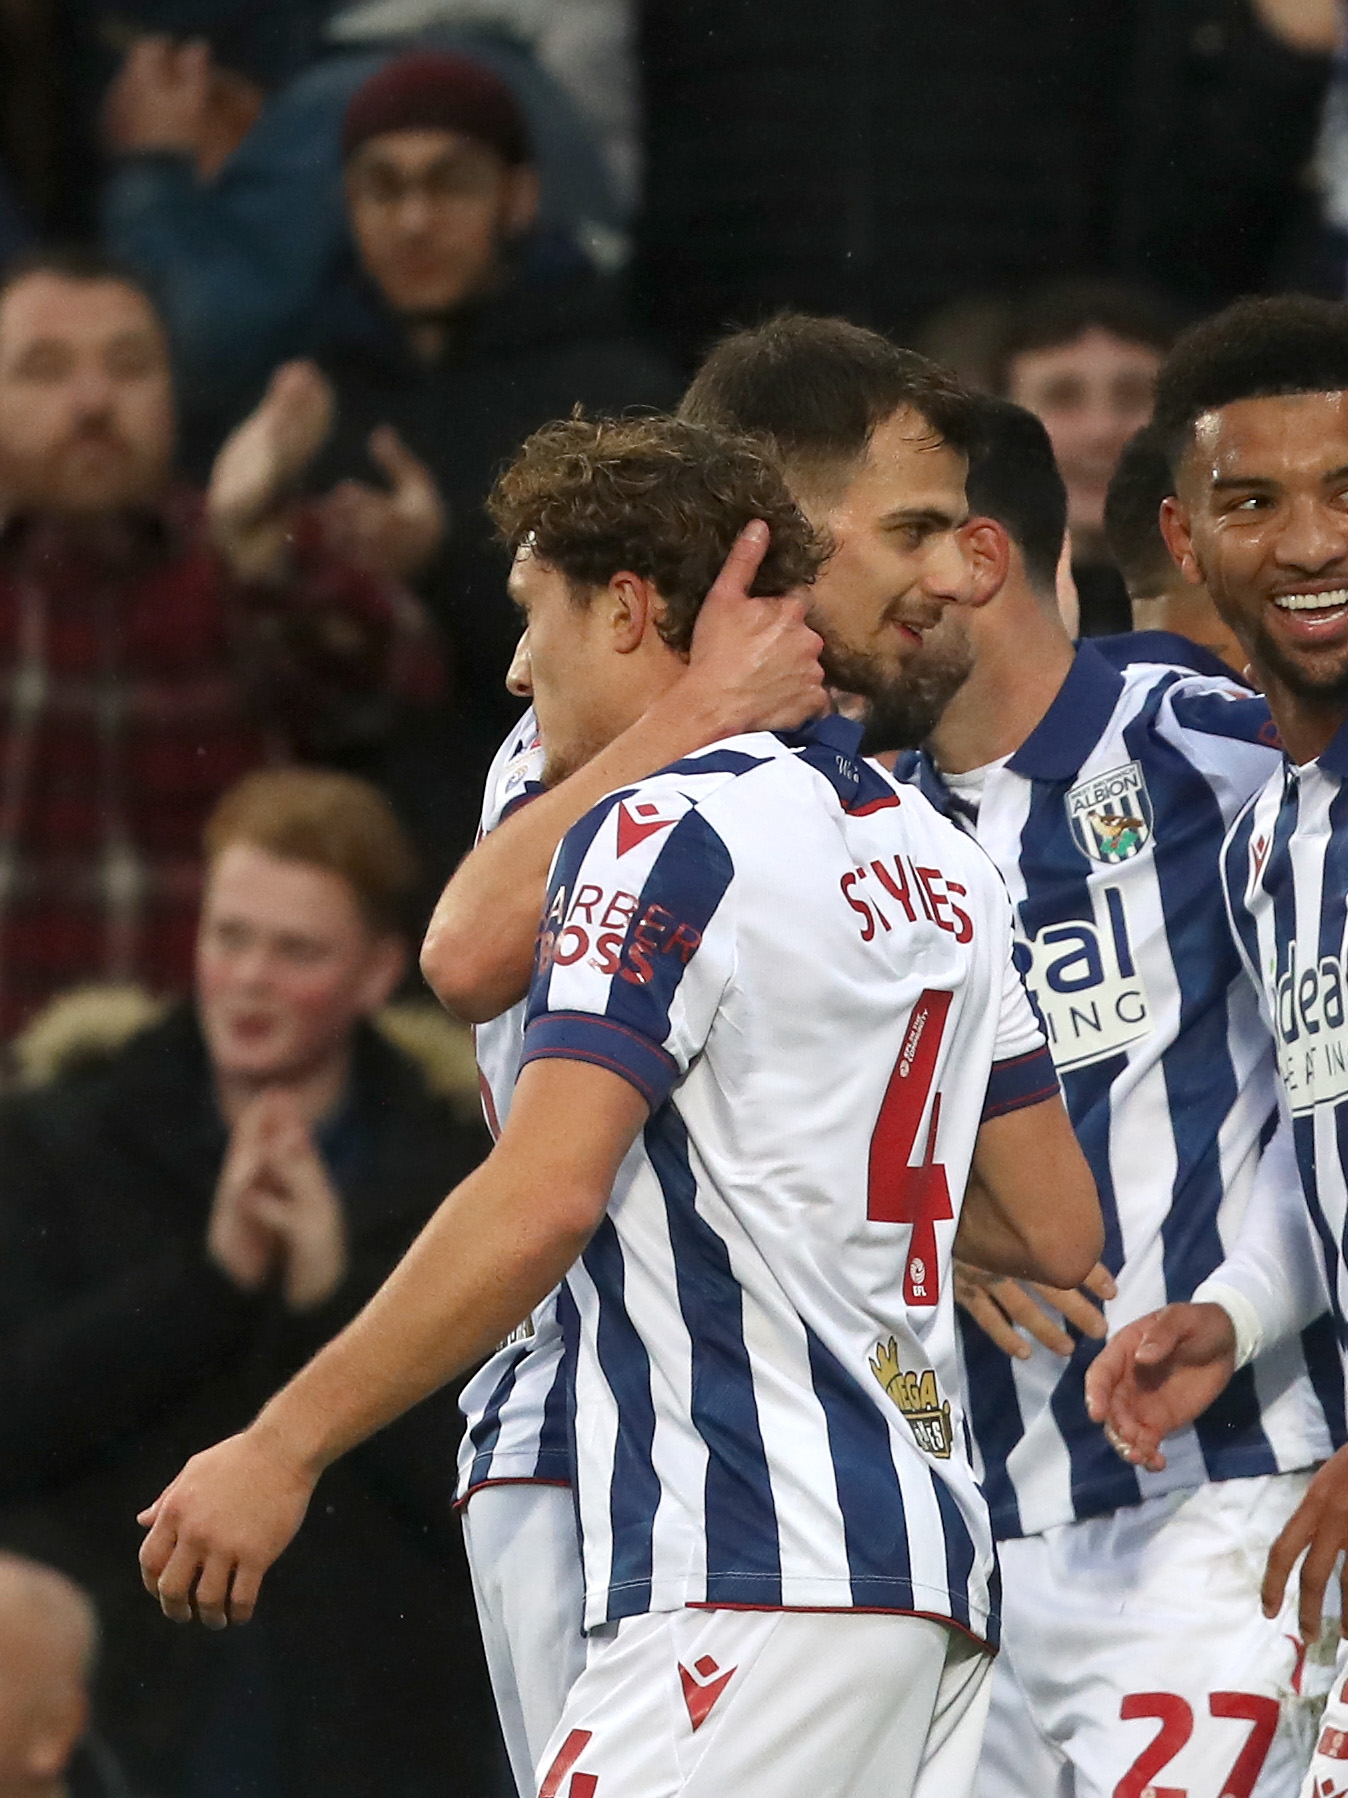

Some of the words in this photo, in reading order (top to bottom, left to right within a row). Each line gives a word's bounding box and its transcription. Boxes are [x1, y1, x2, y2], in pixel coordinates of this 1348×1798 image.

[1074, 773, 1138, 813] ALBION
[545, 884, 703, 963] ARBER
[867, 988, 954, 1306] 4
[912, 1285, 927, 1297] EFL
[1112, 1691, 1280, 1798] 27
